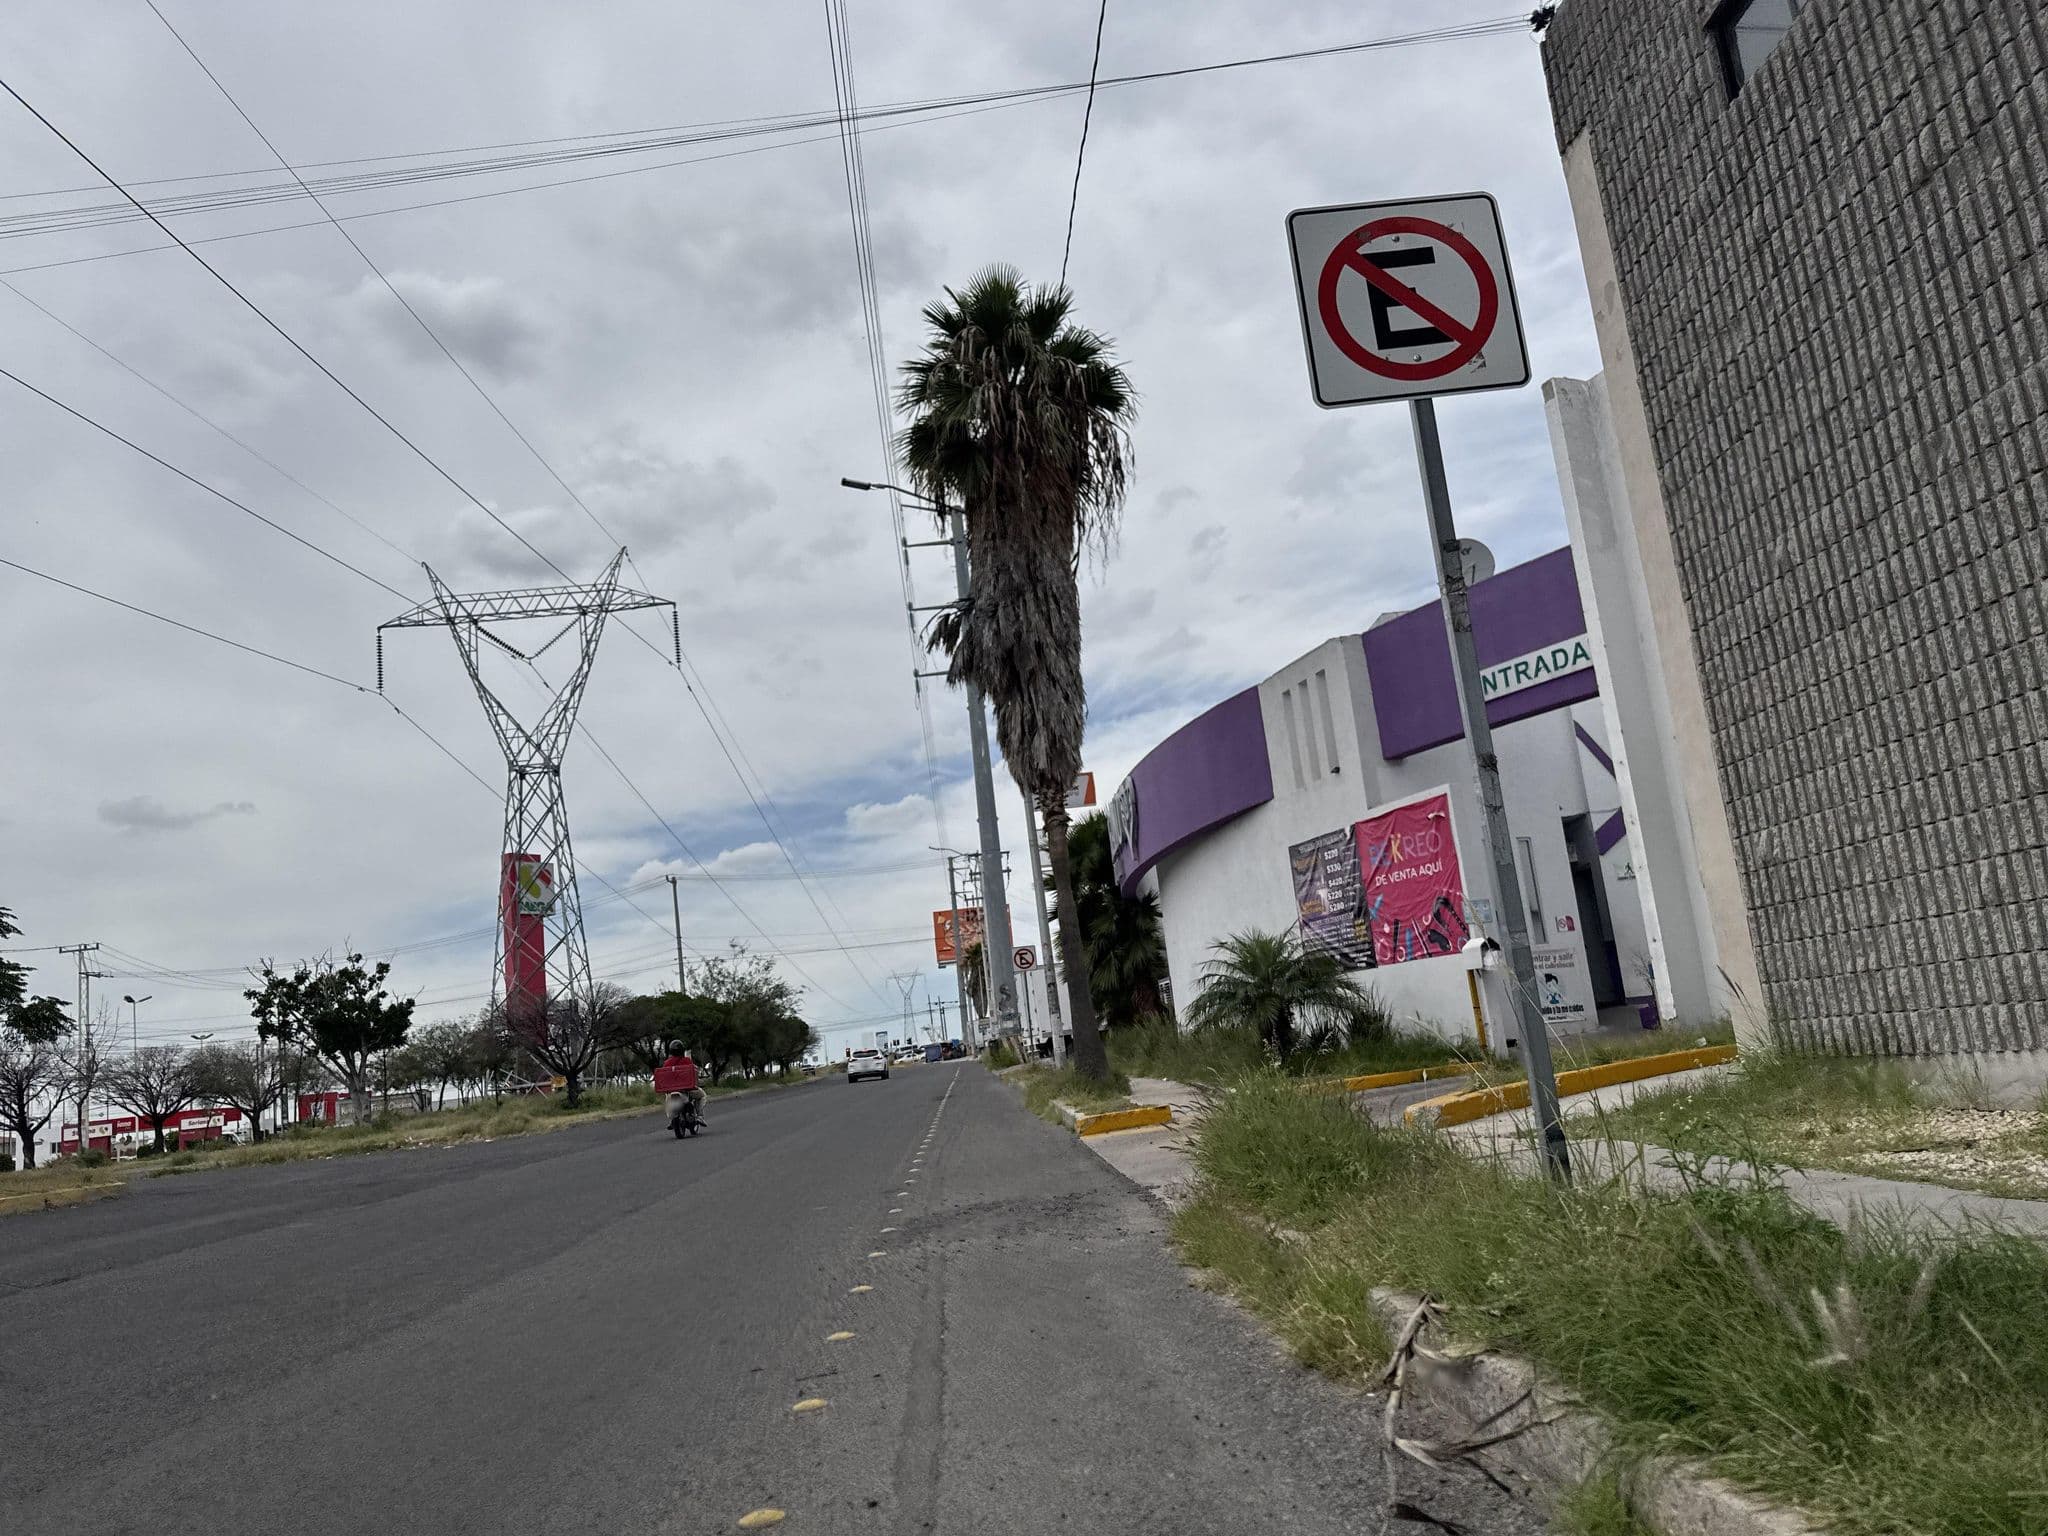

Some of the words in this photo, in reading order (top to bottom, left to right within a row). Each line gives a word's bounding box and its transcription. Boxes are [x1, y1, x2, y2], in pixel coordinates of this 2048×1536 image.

[1361, 246, 1455, 350] E
[1482, 640, 1591, 695] NTRADA
[1375, 874, 1389, 887] DE
[1388, 865, 1417, 883] VENTA
[1418, 857, 1443, 877] AQUÍ
